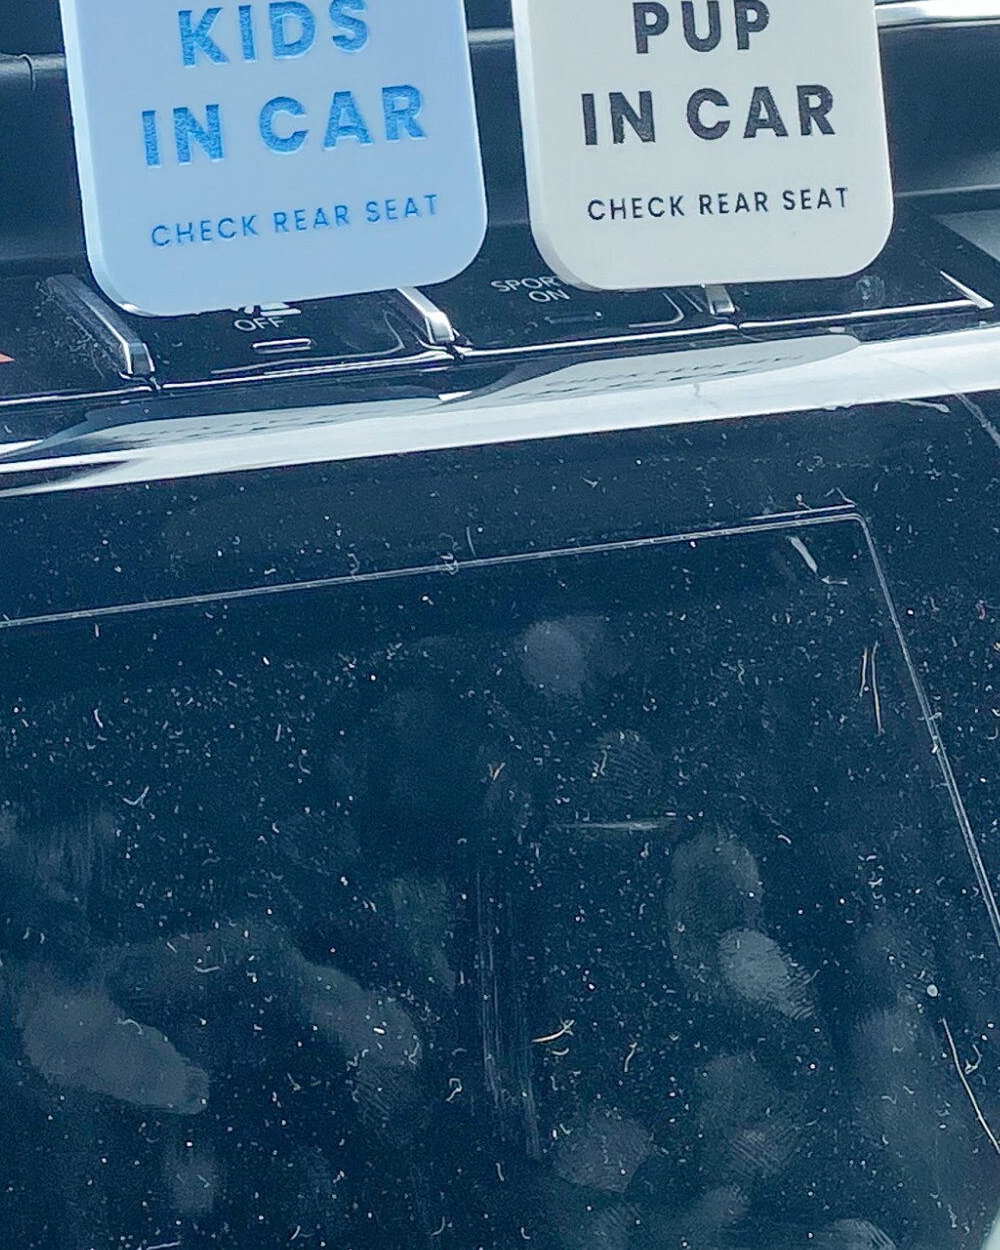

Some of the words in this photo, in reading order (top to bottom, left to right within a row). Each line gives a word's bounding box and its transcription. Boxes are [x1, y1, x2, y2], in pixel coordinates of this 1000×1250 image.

[632, 0, 770, 54] PUP
[142, 104, 224, 166] IN
[258, 84, 426, 152] CAR
[581, 90, 656, 146] IN
[686, 84, 836, 140] CAR
[152, 215, 258, 246] CHECK
[273, 205, 349, 232] REAR
[366, 194, 437, 222] SEAT
[587, 195, 685, 220] CHECK
[699, 191, 768, 215] REAR
[782, 187, 848, 210] SEAT
[490, 275, 561, 292] SPOR
[528, 289, 571, 302] ON
[233, 316, 285, 332] OFF
